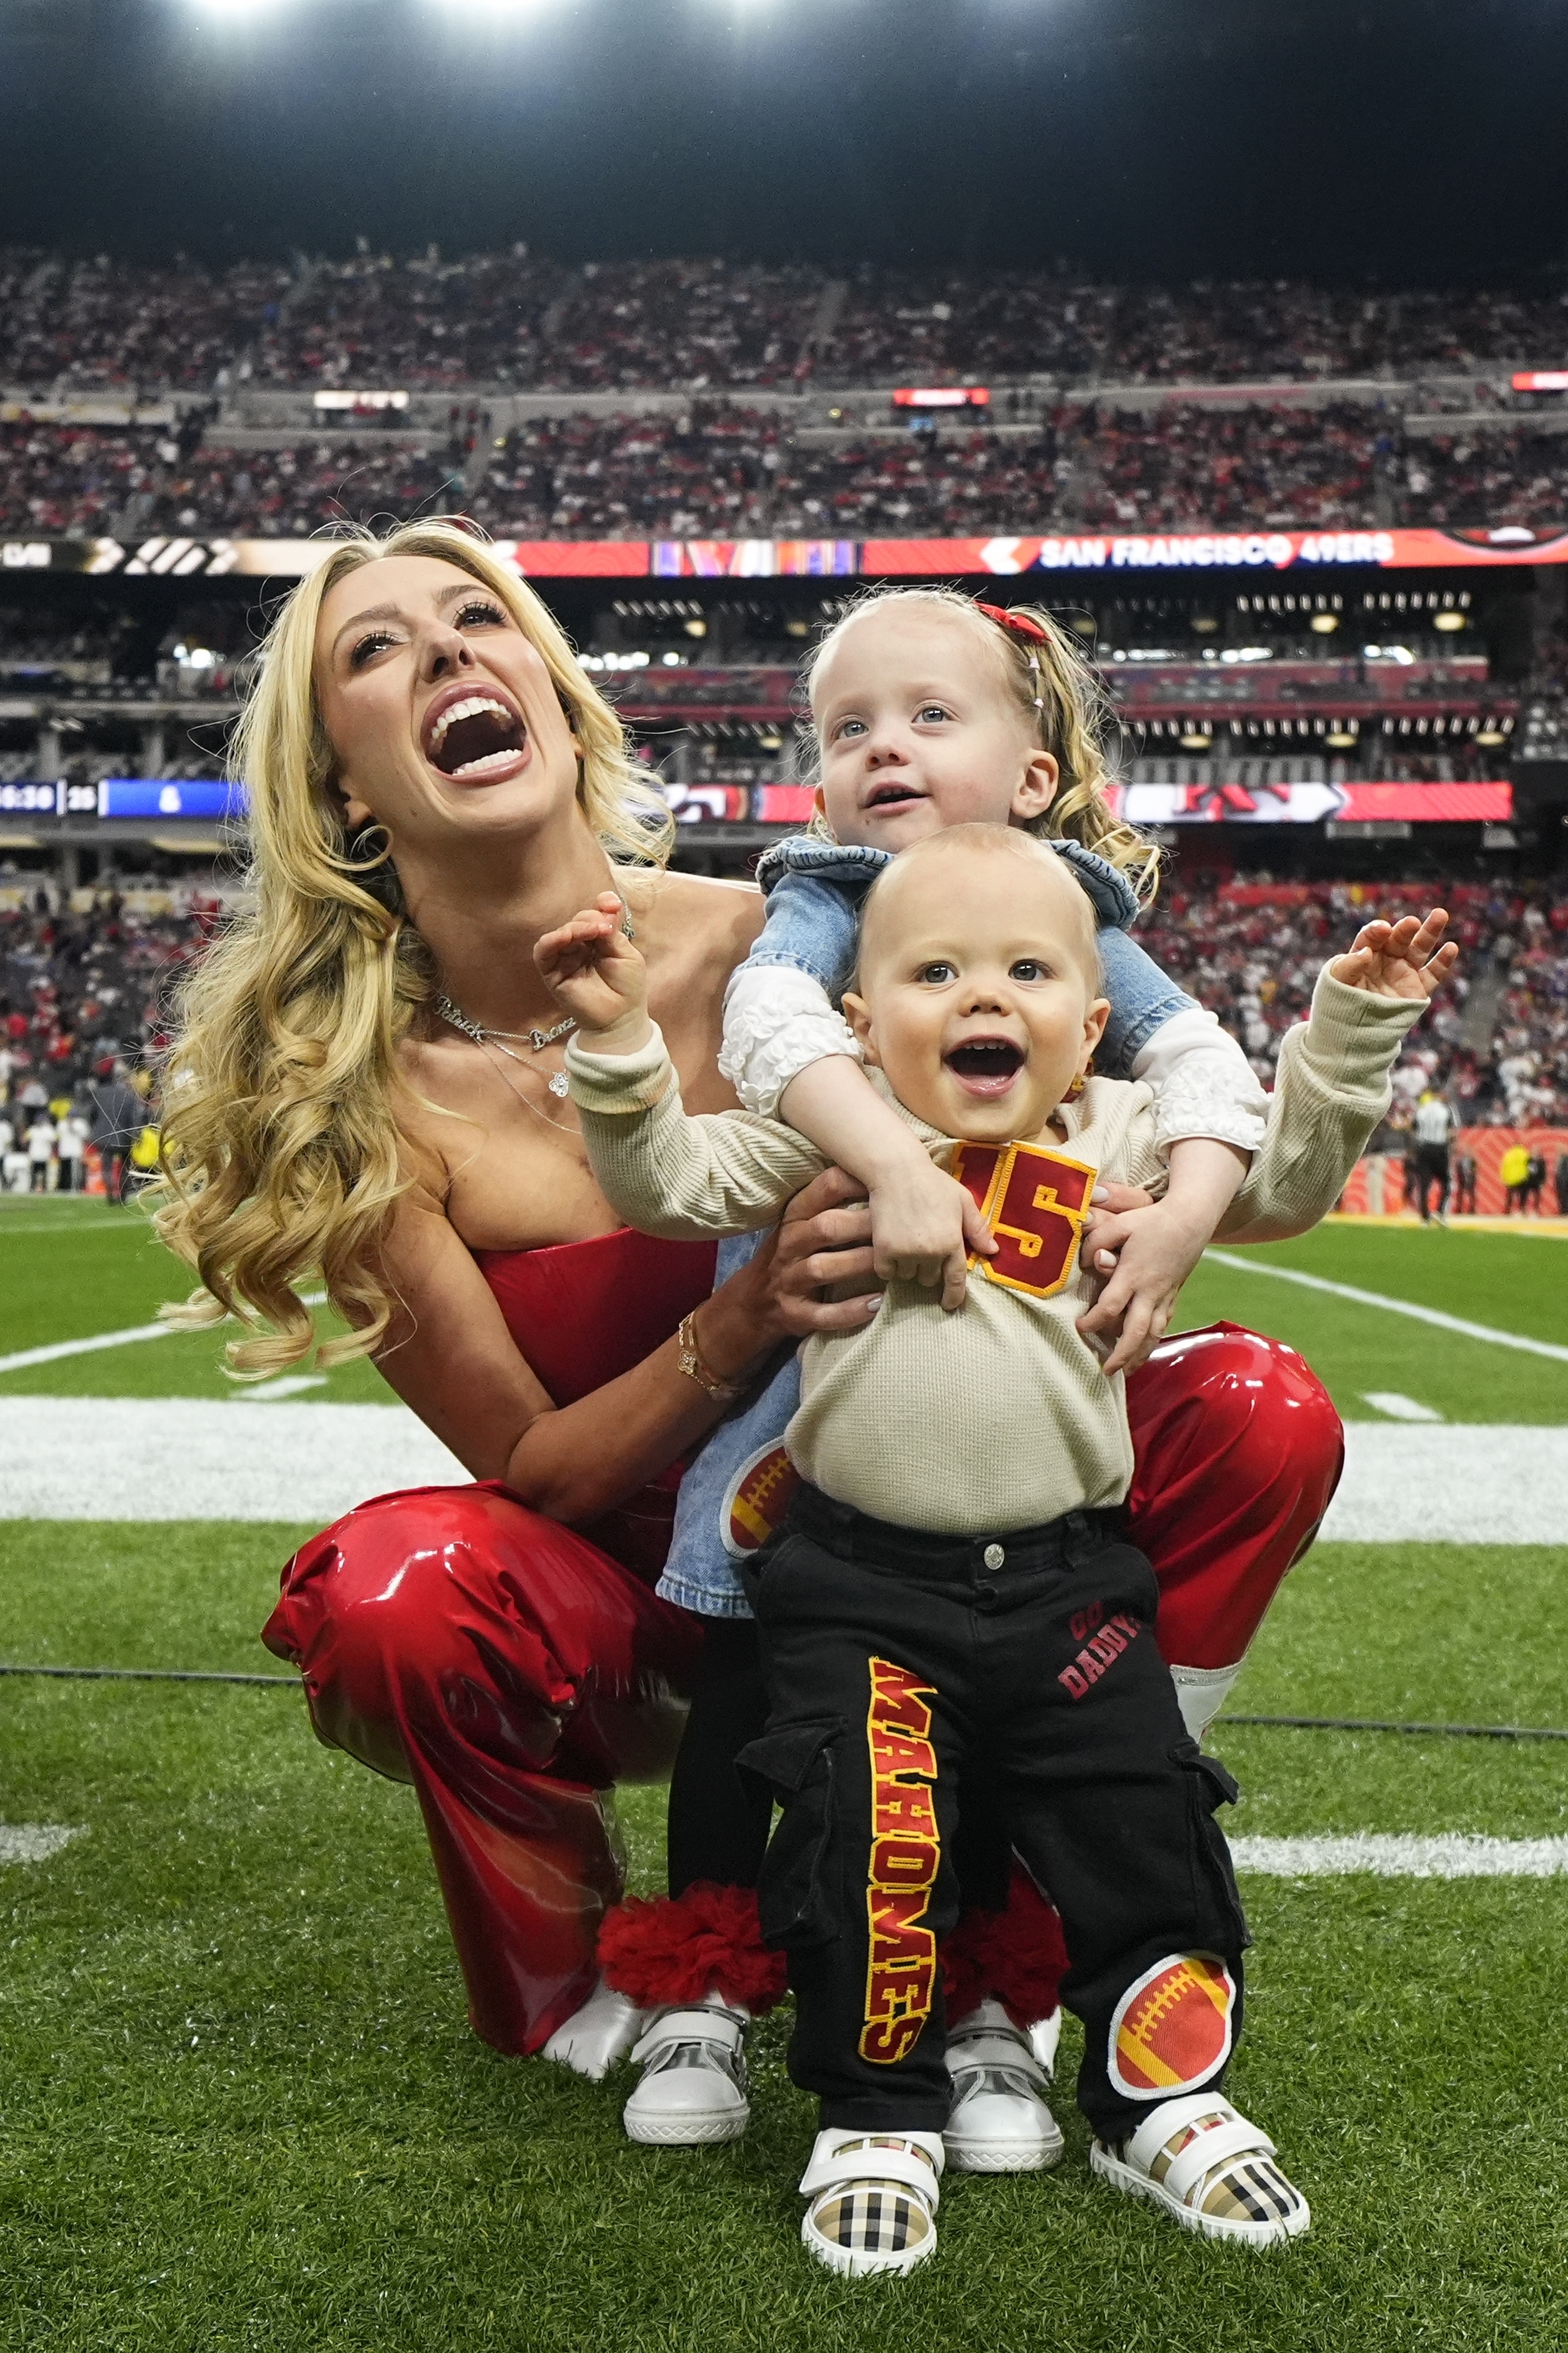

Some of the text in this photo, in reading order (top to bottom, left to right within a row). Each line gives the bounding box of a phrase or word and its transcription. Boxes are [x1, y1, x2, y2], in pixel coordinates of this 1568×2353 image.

[1040, 531, 1394, 568] SAN FRANCISCO 49ERS
[1069, 1599, 1104, 1641] GO
[858, 1656, 940, 2064] MAHOMES
